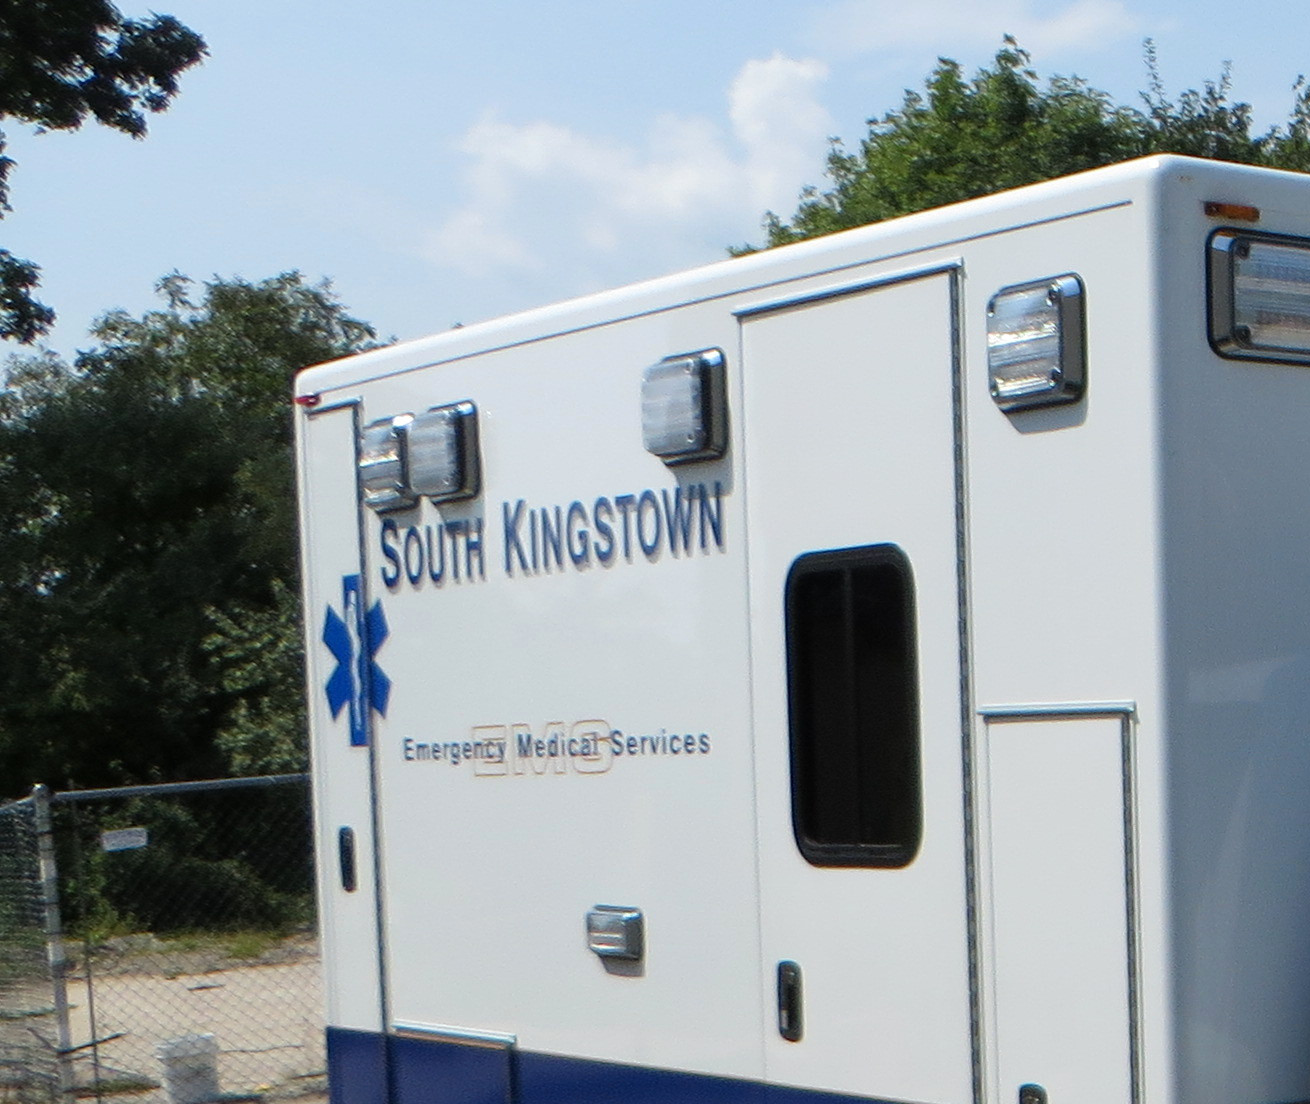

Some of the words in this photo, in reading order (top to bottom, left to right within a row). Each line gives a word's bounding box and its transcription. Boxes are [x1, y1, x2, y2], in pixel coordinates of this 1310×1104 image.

[380, 516, 486, 592] SOUTH
[502, 480, 725, 577] KINGSTOWN
[402, 736, 507, 766] Emergency
[516, 733, 601, 758] Medical
[609, 728, 712, 757] Services
